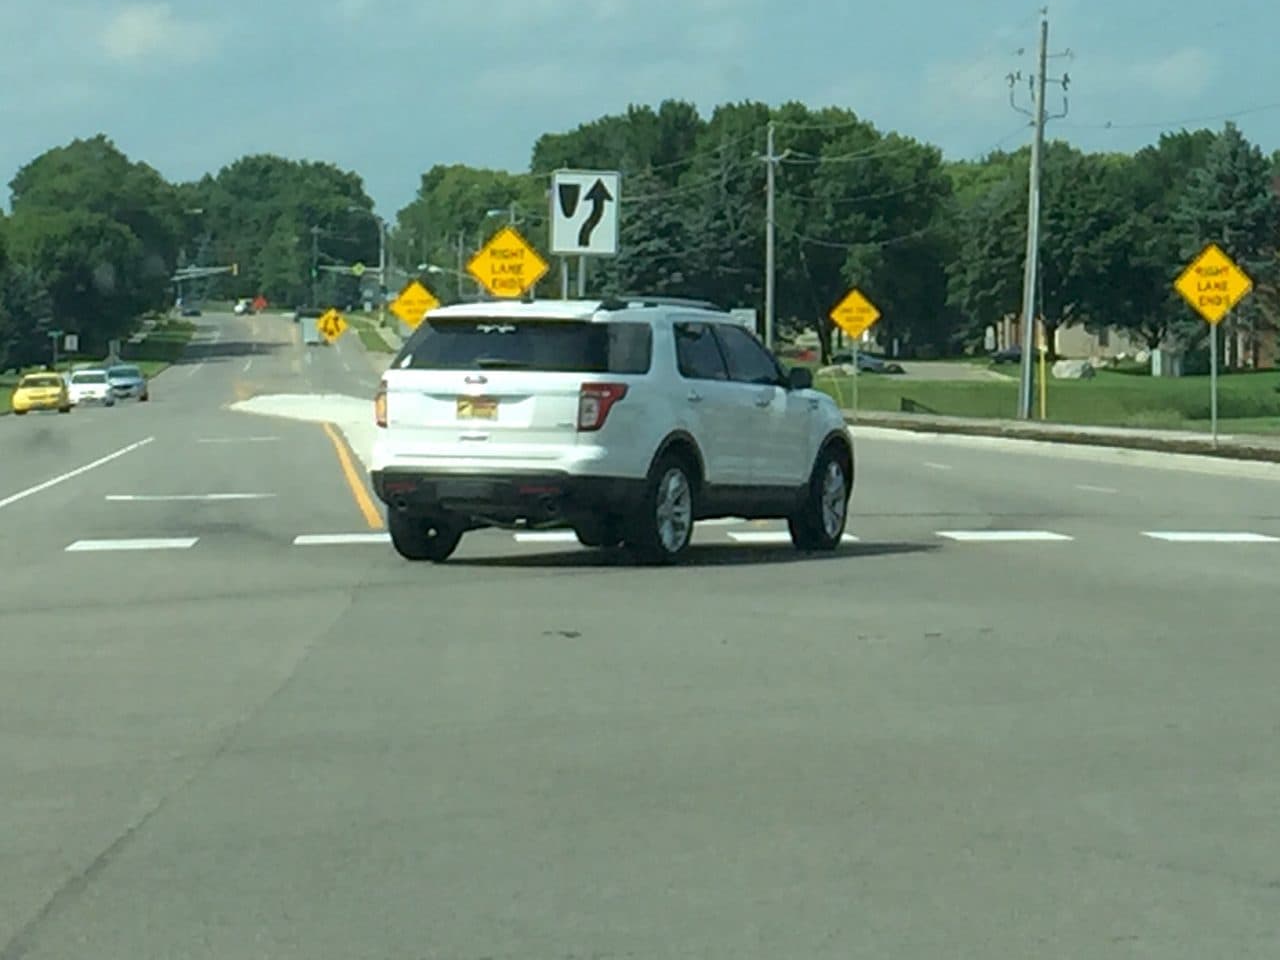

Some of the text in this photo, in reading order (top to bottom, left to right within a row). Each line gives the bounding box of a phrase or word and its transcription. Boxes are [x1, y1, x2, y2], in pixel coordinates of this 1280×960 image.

[490, 248, 525, 260] RIGHT
[491, 263, 524, 275] LANE
[1197, 280, 1228, 292] LANE
